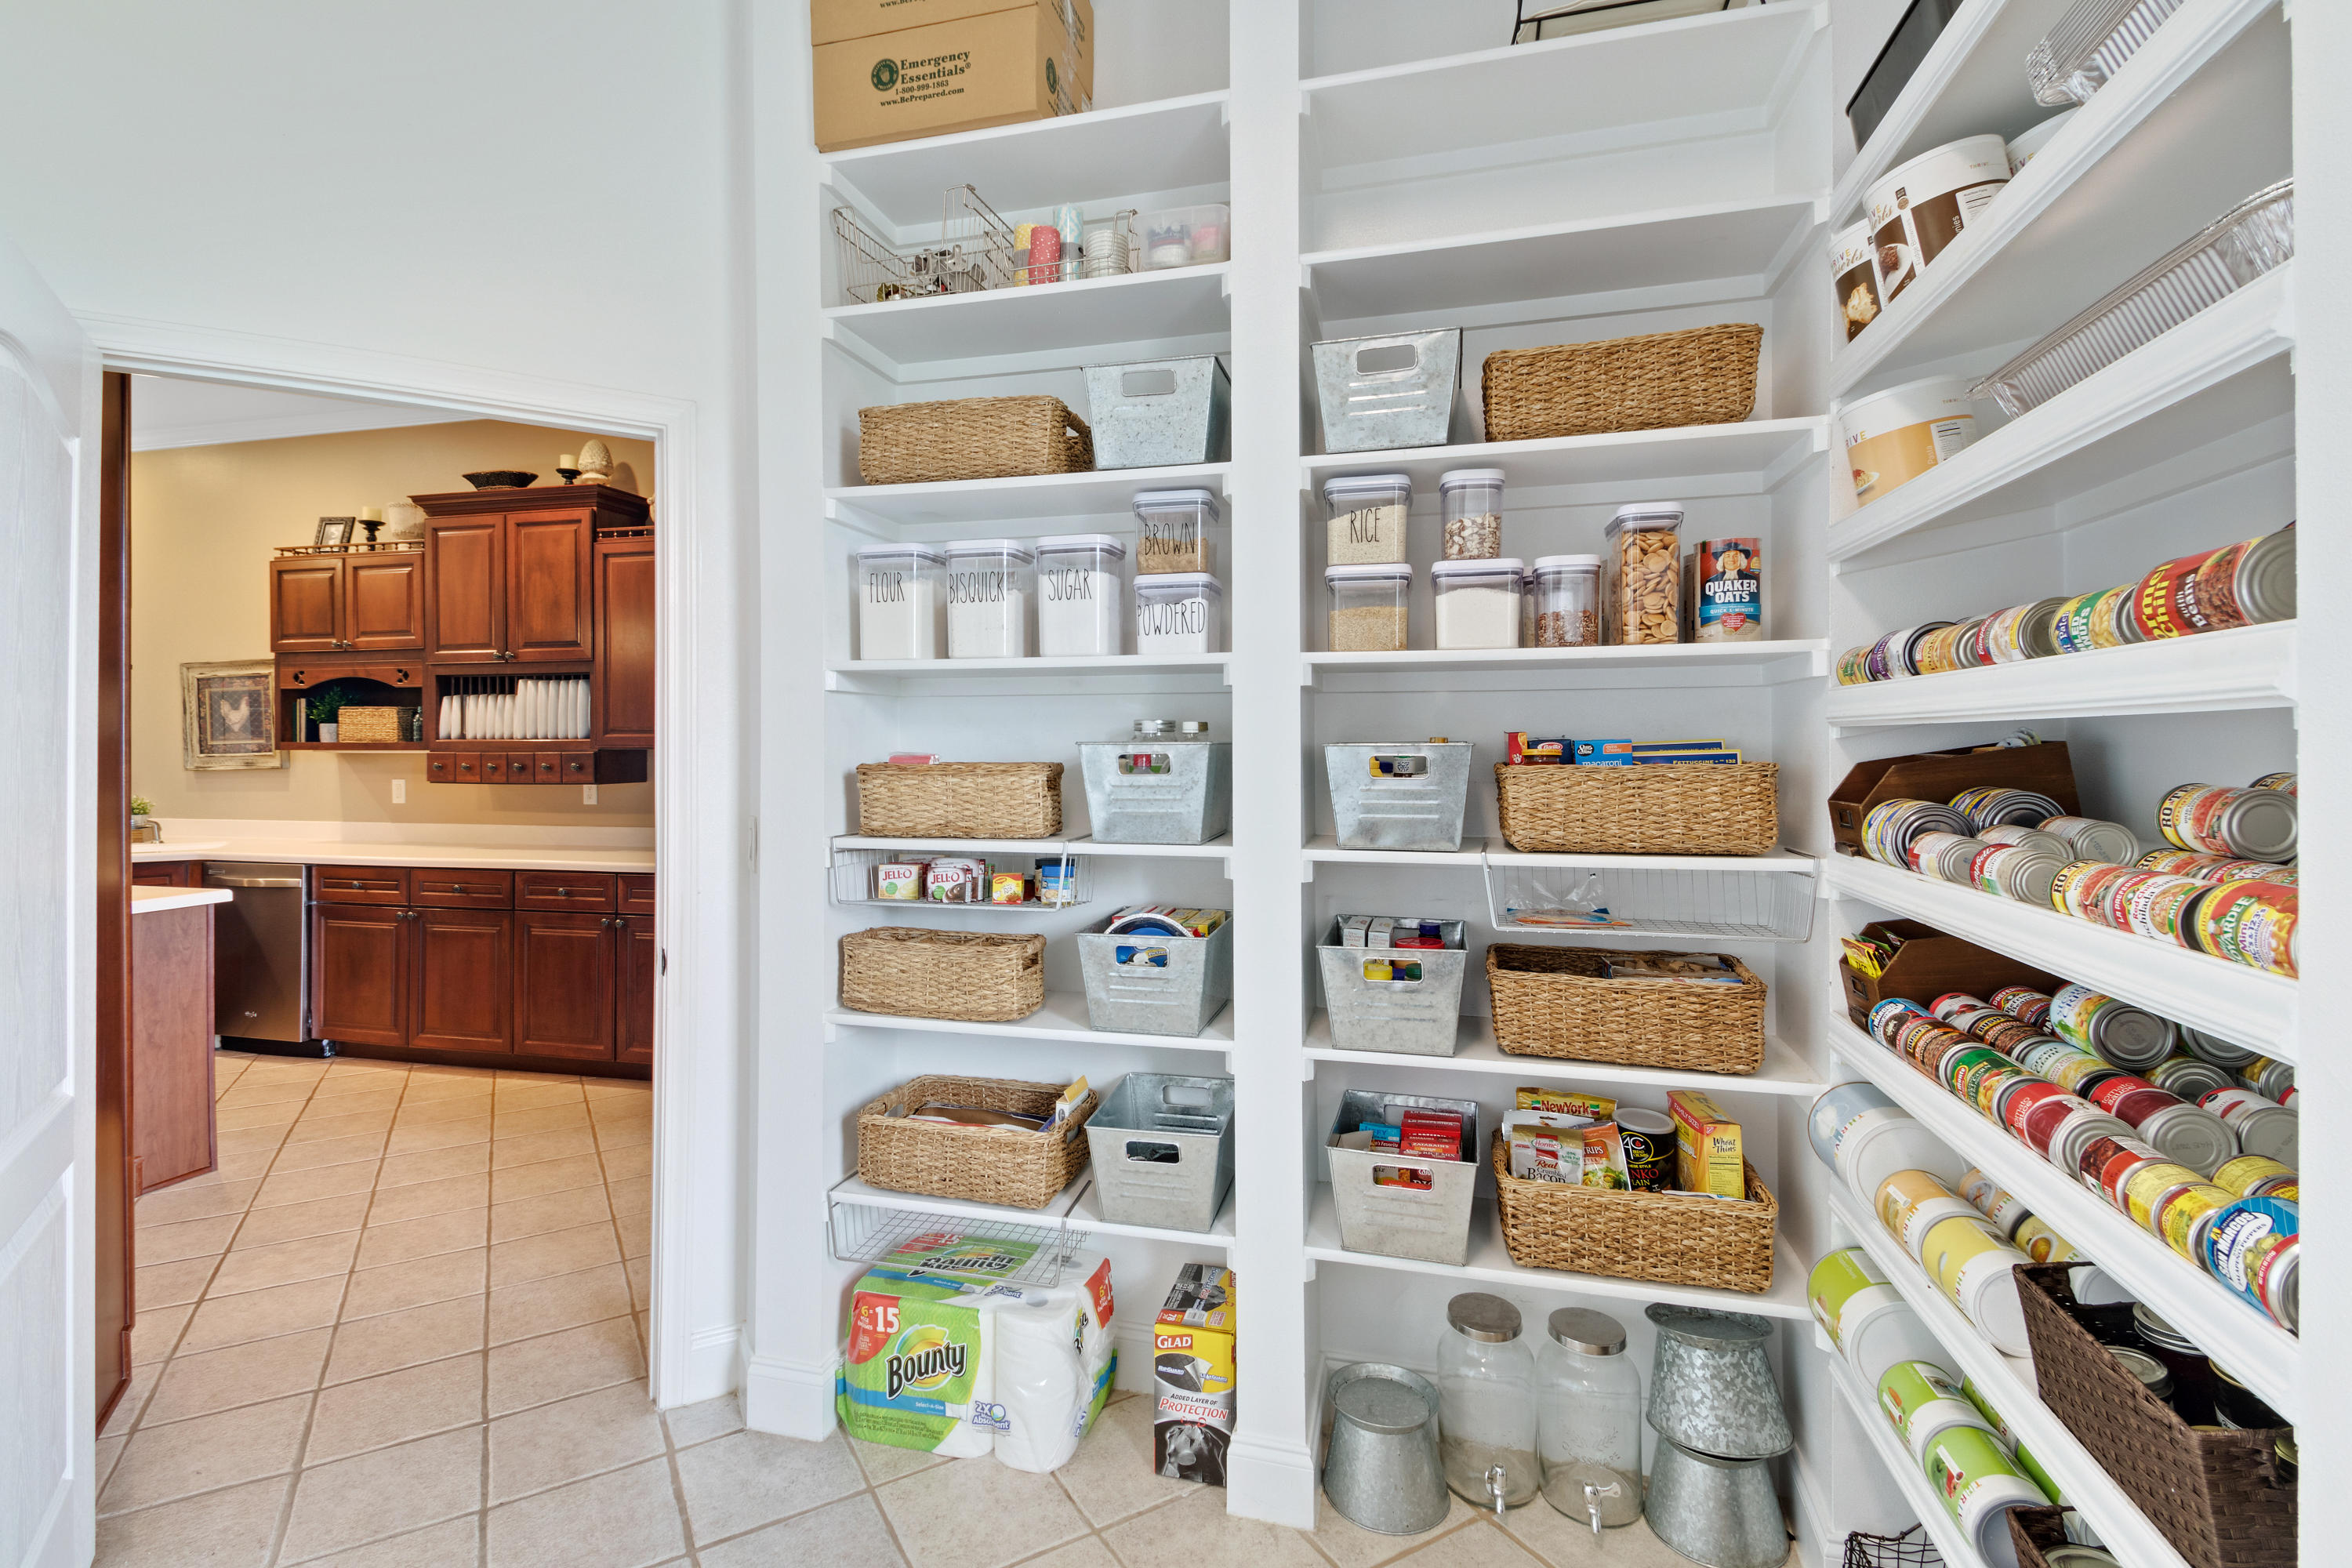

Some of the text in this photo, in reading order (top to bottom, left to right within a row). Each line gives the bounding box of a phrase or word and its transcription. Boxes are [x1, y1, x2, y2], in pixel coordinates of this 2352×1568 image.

[900, 51, 971, 71] Emergency
[880, 88, 964, 107] www.BePrepared.com
[895, 80, 949, 95] 1-800-999-1863
[1349, 507, 1381, 543] RICE
[1144, 521, 1195, 555] BROWN
[869, 571, 905, 603] FLOUR
[949, 571, 1005, 604] BISQUICK
[1047, 568, 1092, 601] SUGAR
[1705, 579, 1757, 596] QUAKER
[1715, 591, 1750, 603] OATS
[2184, 573, 2208, 627] Beans
[1137, 601, 1205, 636] POWDERED
[2153, 580, 2179, 637] Chili
[2114, 875, 2150, 923] LA PREFERIDA
[2168, 895, 2185, 919] MILD
[2238, 923, 2249, 952] Mini
[2005, 992, 2034, 1014] Refried
[2011, 996, 2037, 1014] Beans
[1908, 1025, 1929, 1051] BUSH'S
[2102, 1082, 2135, 1105] tomato
[2107, 1085, 2136, 1105] sauce
[1674, 1102, 1688, 1119] FAMILY
[2014, 1097, 2031, 1127] tomato
[2018, 1100, 2033, 1129] sauce
[1535, 1138, 1559, 1149] Hormel
[1712, 1145, 1737, 1154] Thins
[1713, 1137, 1736, 1146] Wheat
[1526, 1168, 1566, 1183] Bacon
[1535, 1160, 1558, 1169] Real
[1537, 1167, 1566, 1179] Crumbled
[2217, 1211, 2257, 1255] MARCOS
[2218, 1250, 2230, 1279] SAN
[861, 1305, 869, 1317] 6
[875, 1305, 901, 1334] 15
[1157, 1335, 1192, 1348] GLAD
[885, 1341, 968, 1400] Bounty
[975, 1400, 993, 1416] 2X
[1159, 1398, 1229, 1420] PROTECTION
[1171, 1392, 1190, 1402] ADDED
[1191, 1396, 1210, 1405] LAYER
[972, 1414, 1011, 1430] Absorbent
